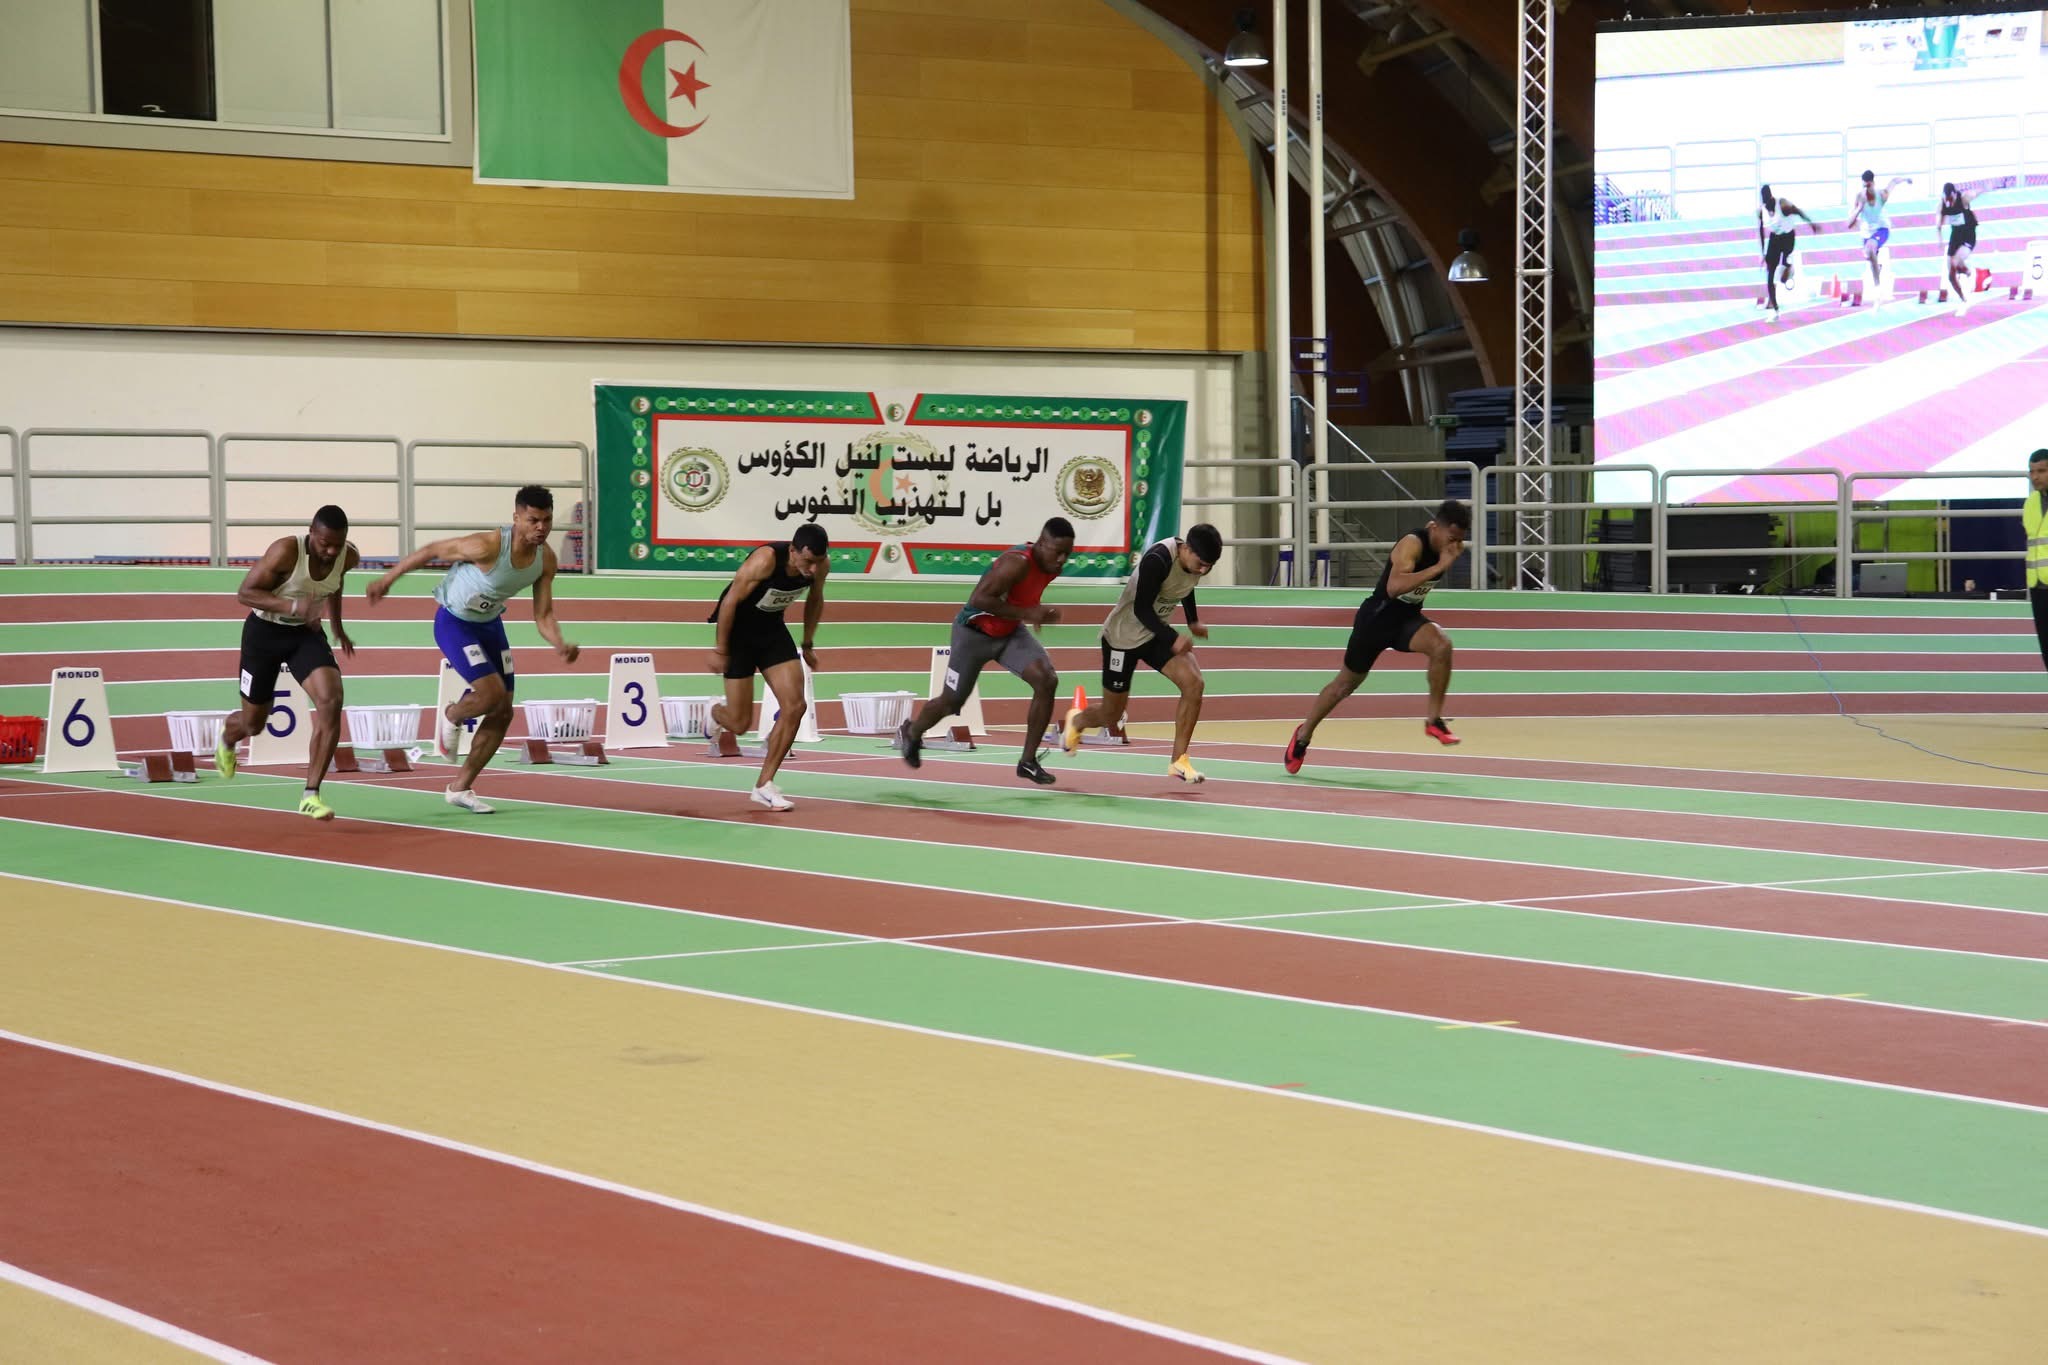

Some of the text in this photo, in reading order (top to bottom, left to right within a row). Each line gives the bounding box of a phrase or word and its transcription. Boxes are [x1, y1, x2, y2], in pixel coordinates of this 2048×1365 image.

[737, 440, 1049, 482] الرياضة ليست لنيل الكؤوس
[975, 491, 1002, 527] بل
[57, 671, 99, 679] MONDO
[615, 656, 650, 664] MONDO
[1111, 657, 1121, 667] 03
[62, 698, 95, 748] 6
[266, 690, 297, 738] 5
[621, 681, 647, 727] 3
